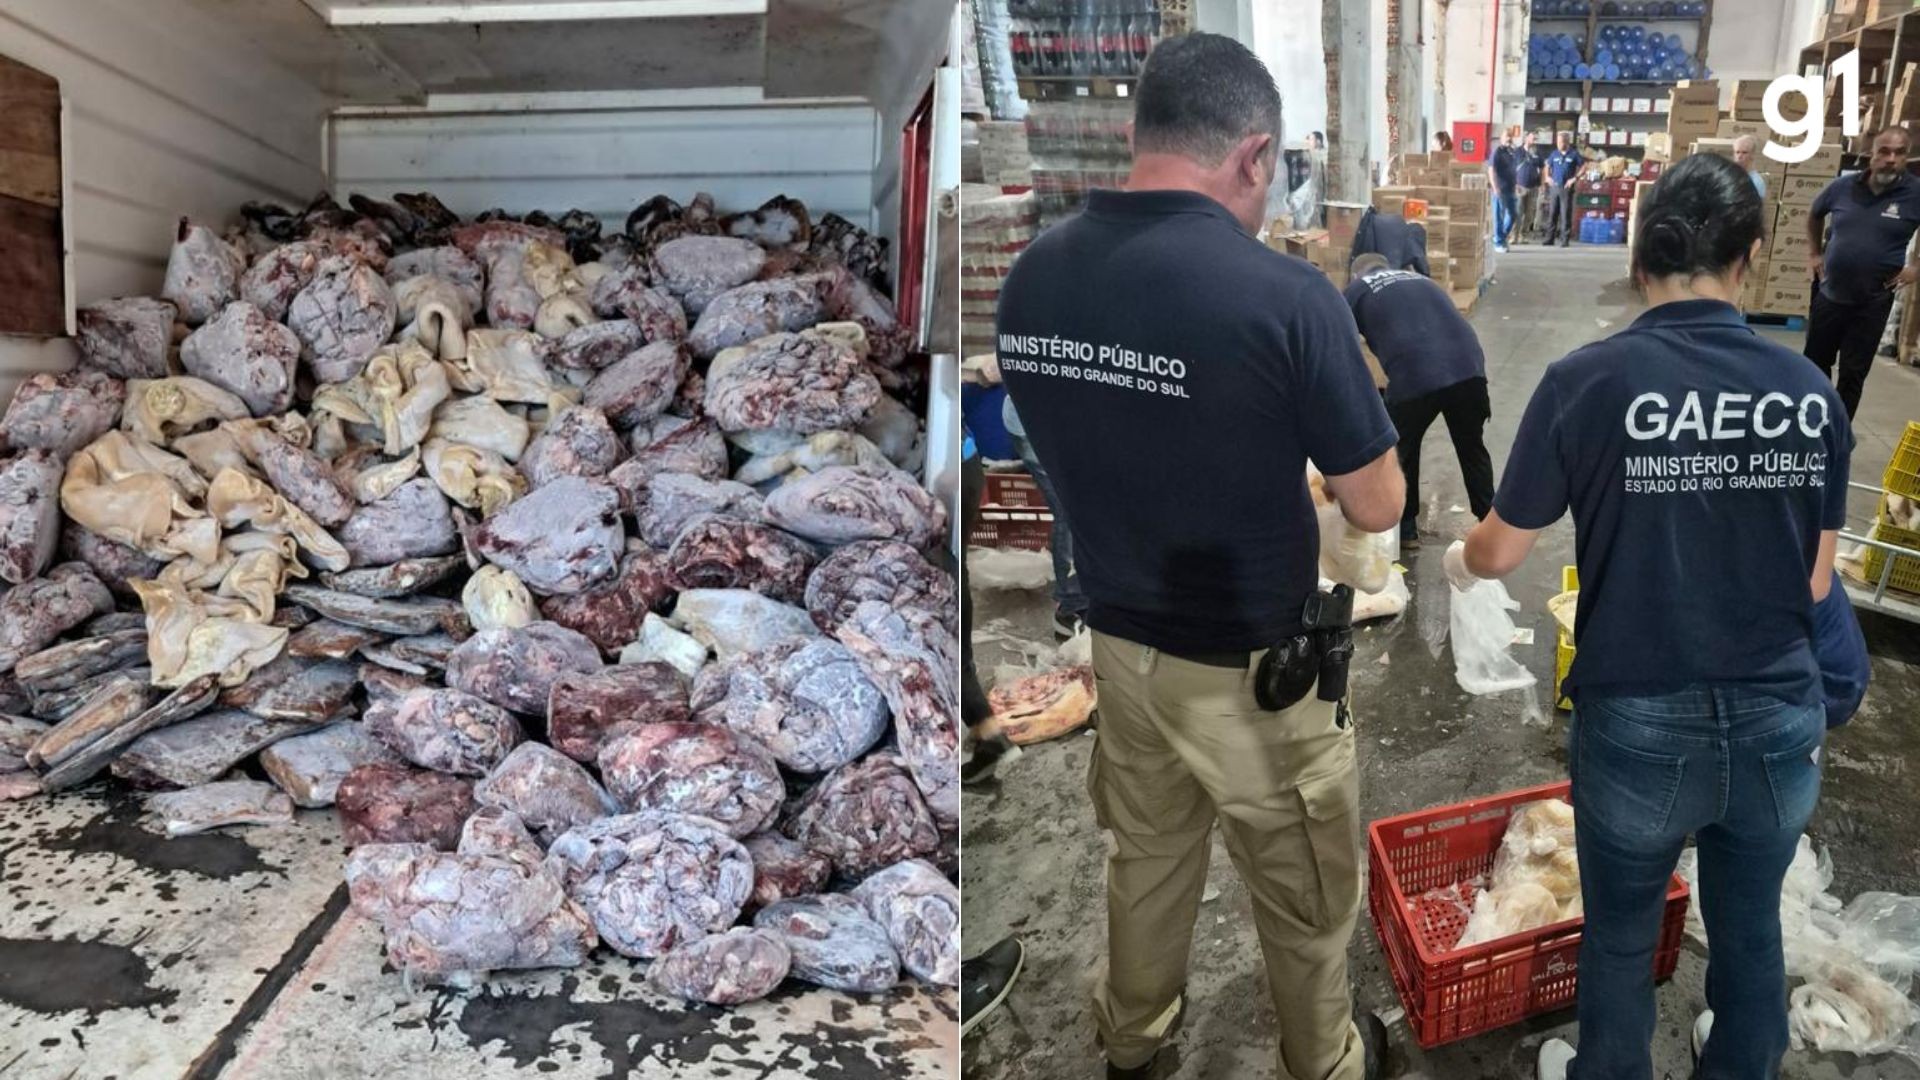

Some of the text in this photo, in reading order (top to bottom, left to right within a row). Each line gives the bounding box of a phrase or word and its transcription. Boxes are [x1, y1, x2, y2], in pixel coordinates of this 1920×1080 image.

[999, 334, 1186, 379] MINISTÉRIO PÚBLICO
[1002, 358, 1190, 399] ESTADO DO RIO GRANDE DO SUL
[1625, 390, 1829, 441] GAECO
[1625, 452, 1739, 477] MINISTÉRIO
[1625, 479, 1676, 494] ESTADO
[1681, 478, 1698, 491] DO
[1703, 477, 1723, 491] RIO
[1729, 474, 1786, 489] GRANDE
[1789, 474, 1805, 487] DO
